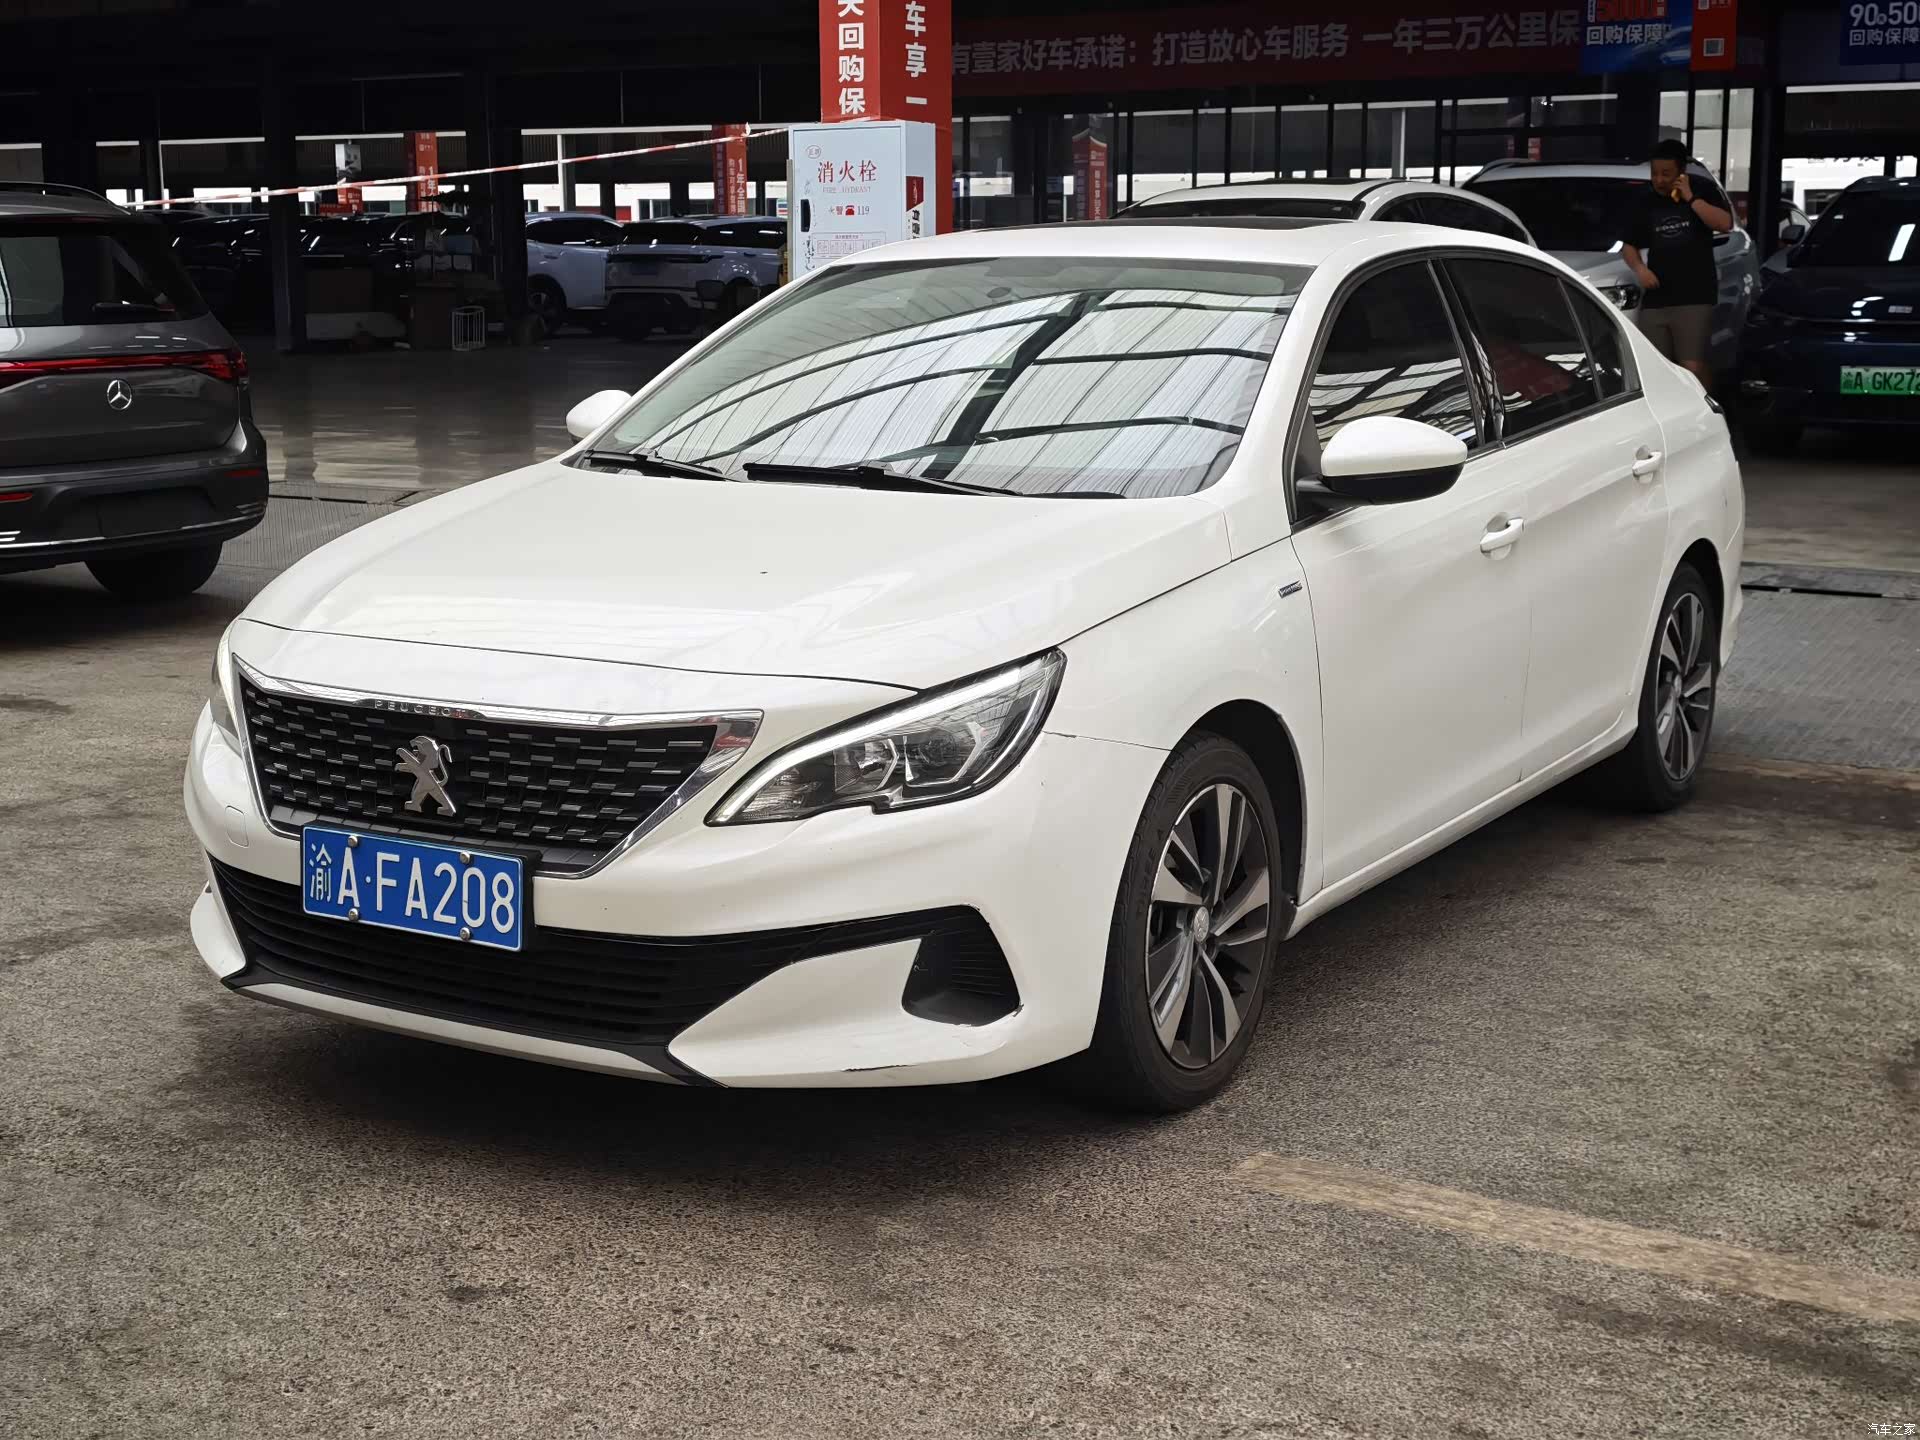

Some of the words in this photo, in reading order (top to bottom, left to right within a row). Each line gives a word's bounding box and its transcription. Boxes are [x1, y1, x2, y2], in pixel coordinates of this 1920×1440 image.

[817, 159, 877, 184] 消火栓
[857, 205, 870, 216] 119
[374, 700, 467, 719] PEUGEOT
